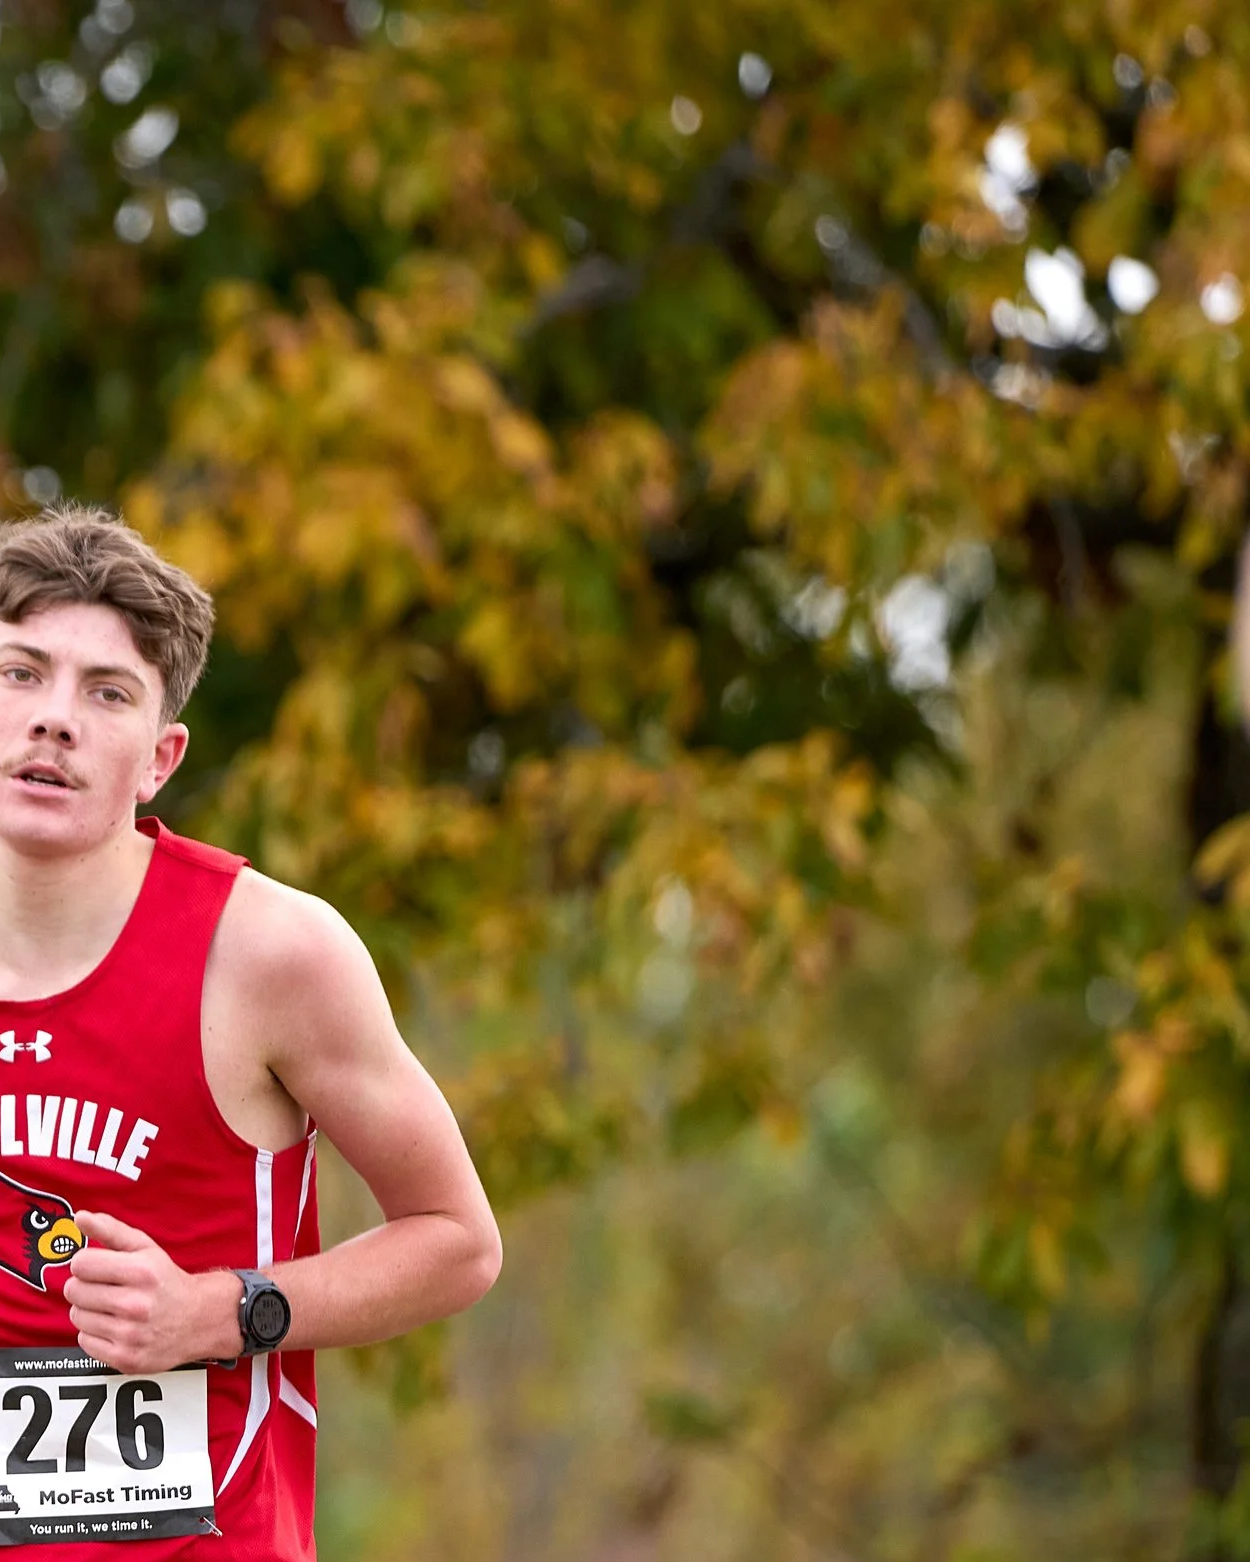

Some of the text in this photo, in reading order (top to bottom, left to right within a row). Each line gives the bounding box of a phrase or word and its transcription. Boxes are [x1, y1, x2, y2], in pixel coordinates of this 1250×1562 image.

[14, 1357, 110, 1371] www.mofasttim
[2, 1379, 164, 1475] 276
[39, 1484, 192, 1505] MoFast Timing
[30, 1519, 153, 1535] You run it, we time it.
